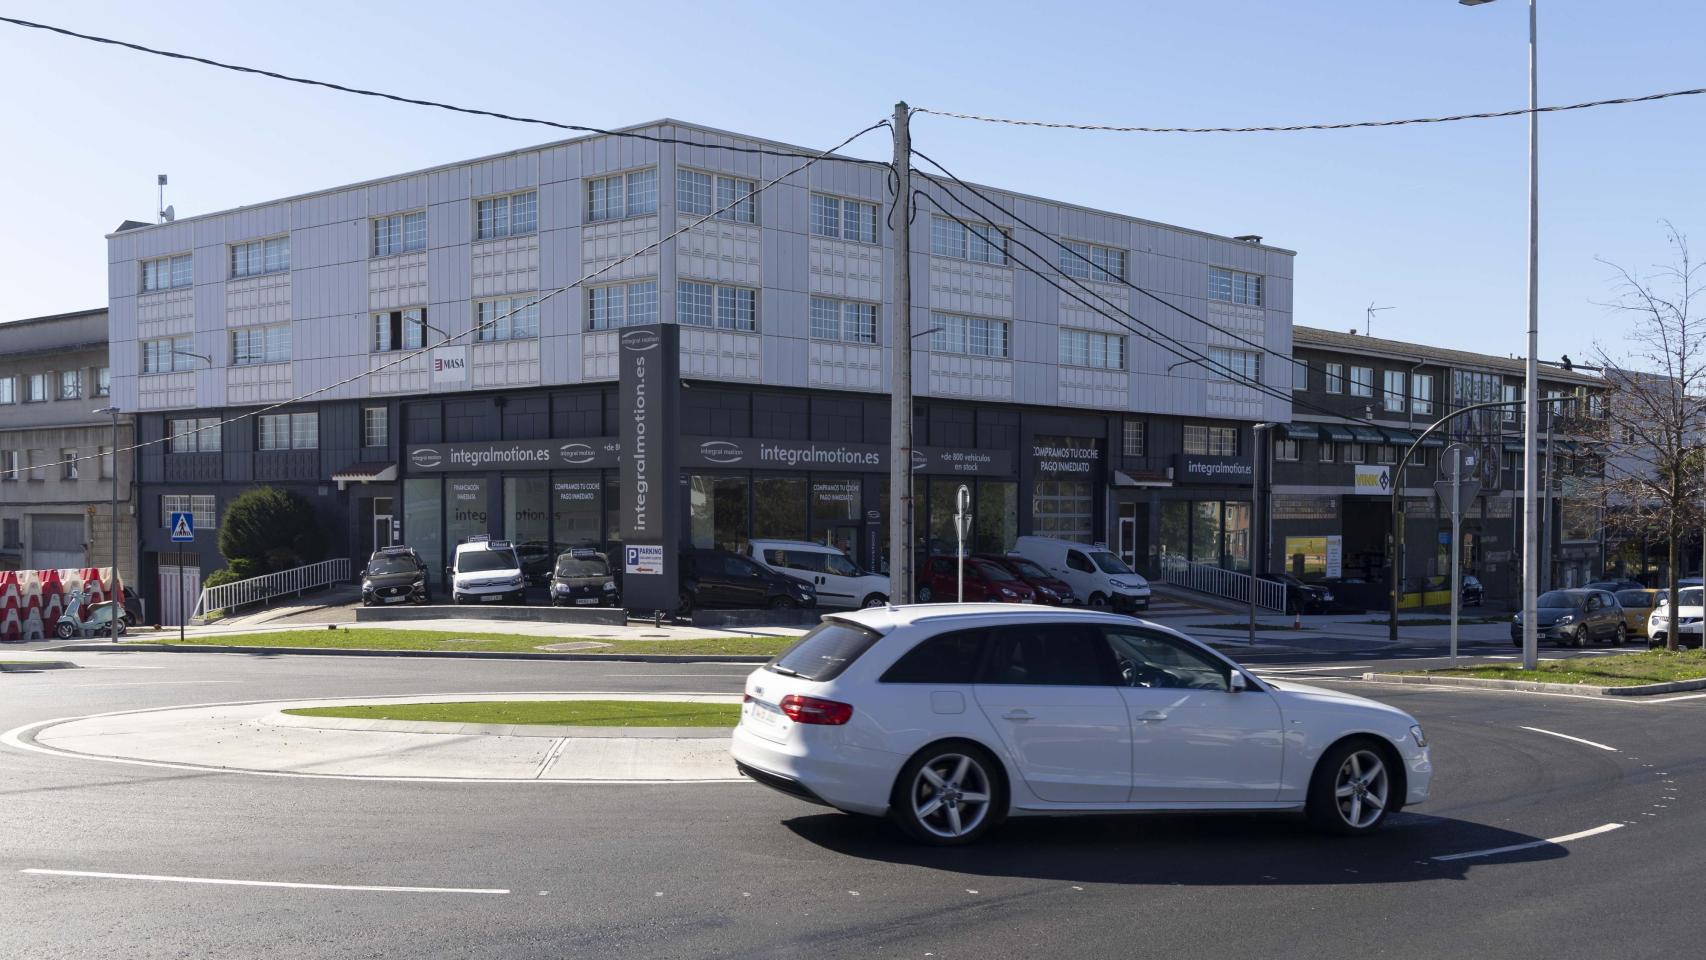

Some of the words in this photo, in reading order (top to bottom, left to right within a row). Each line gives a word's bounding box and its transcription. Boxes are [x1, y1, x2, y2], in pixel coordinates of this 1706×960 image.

[443, 358, 465, 369] MASA
[633, 356, 649, 531] integralmotion.es
[450, 446, 550, 466] integralmotion.es
[760, 443, 880, 466] integralmotion.es
[1070, 448, 1078, 458] TU
[1079, 448, 1099, 459] COCHE
[1040, 461, 1058, 471] PAGO
[1058, 462, 1090, 472] INMEDIATO
[1188, 460, 1252, 476] integralmotion.es
[629, 549, 637, 564] P
[639, 547, 662, 555] PARKING
